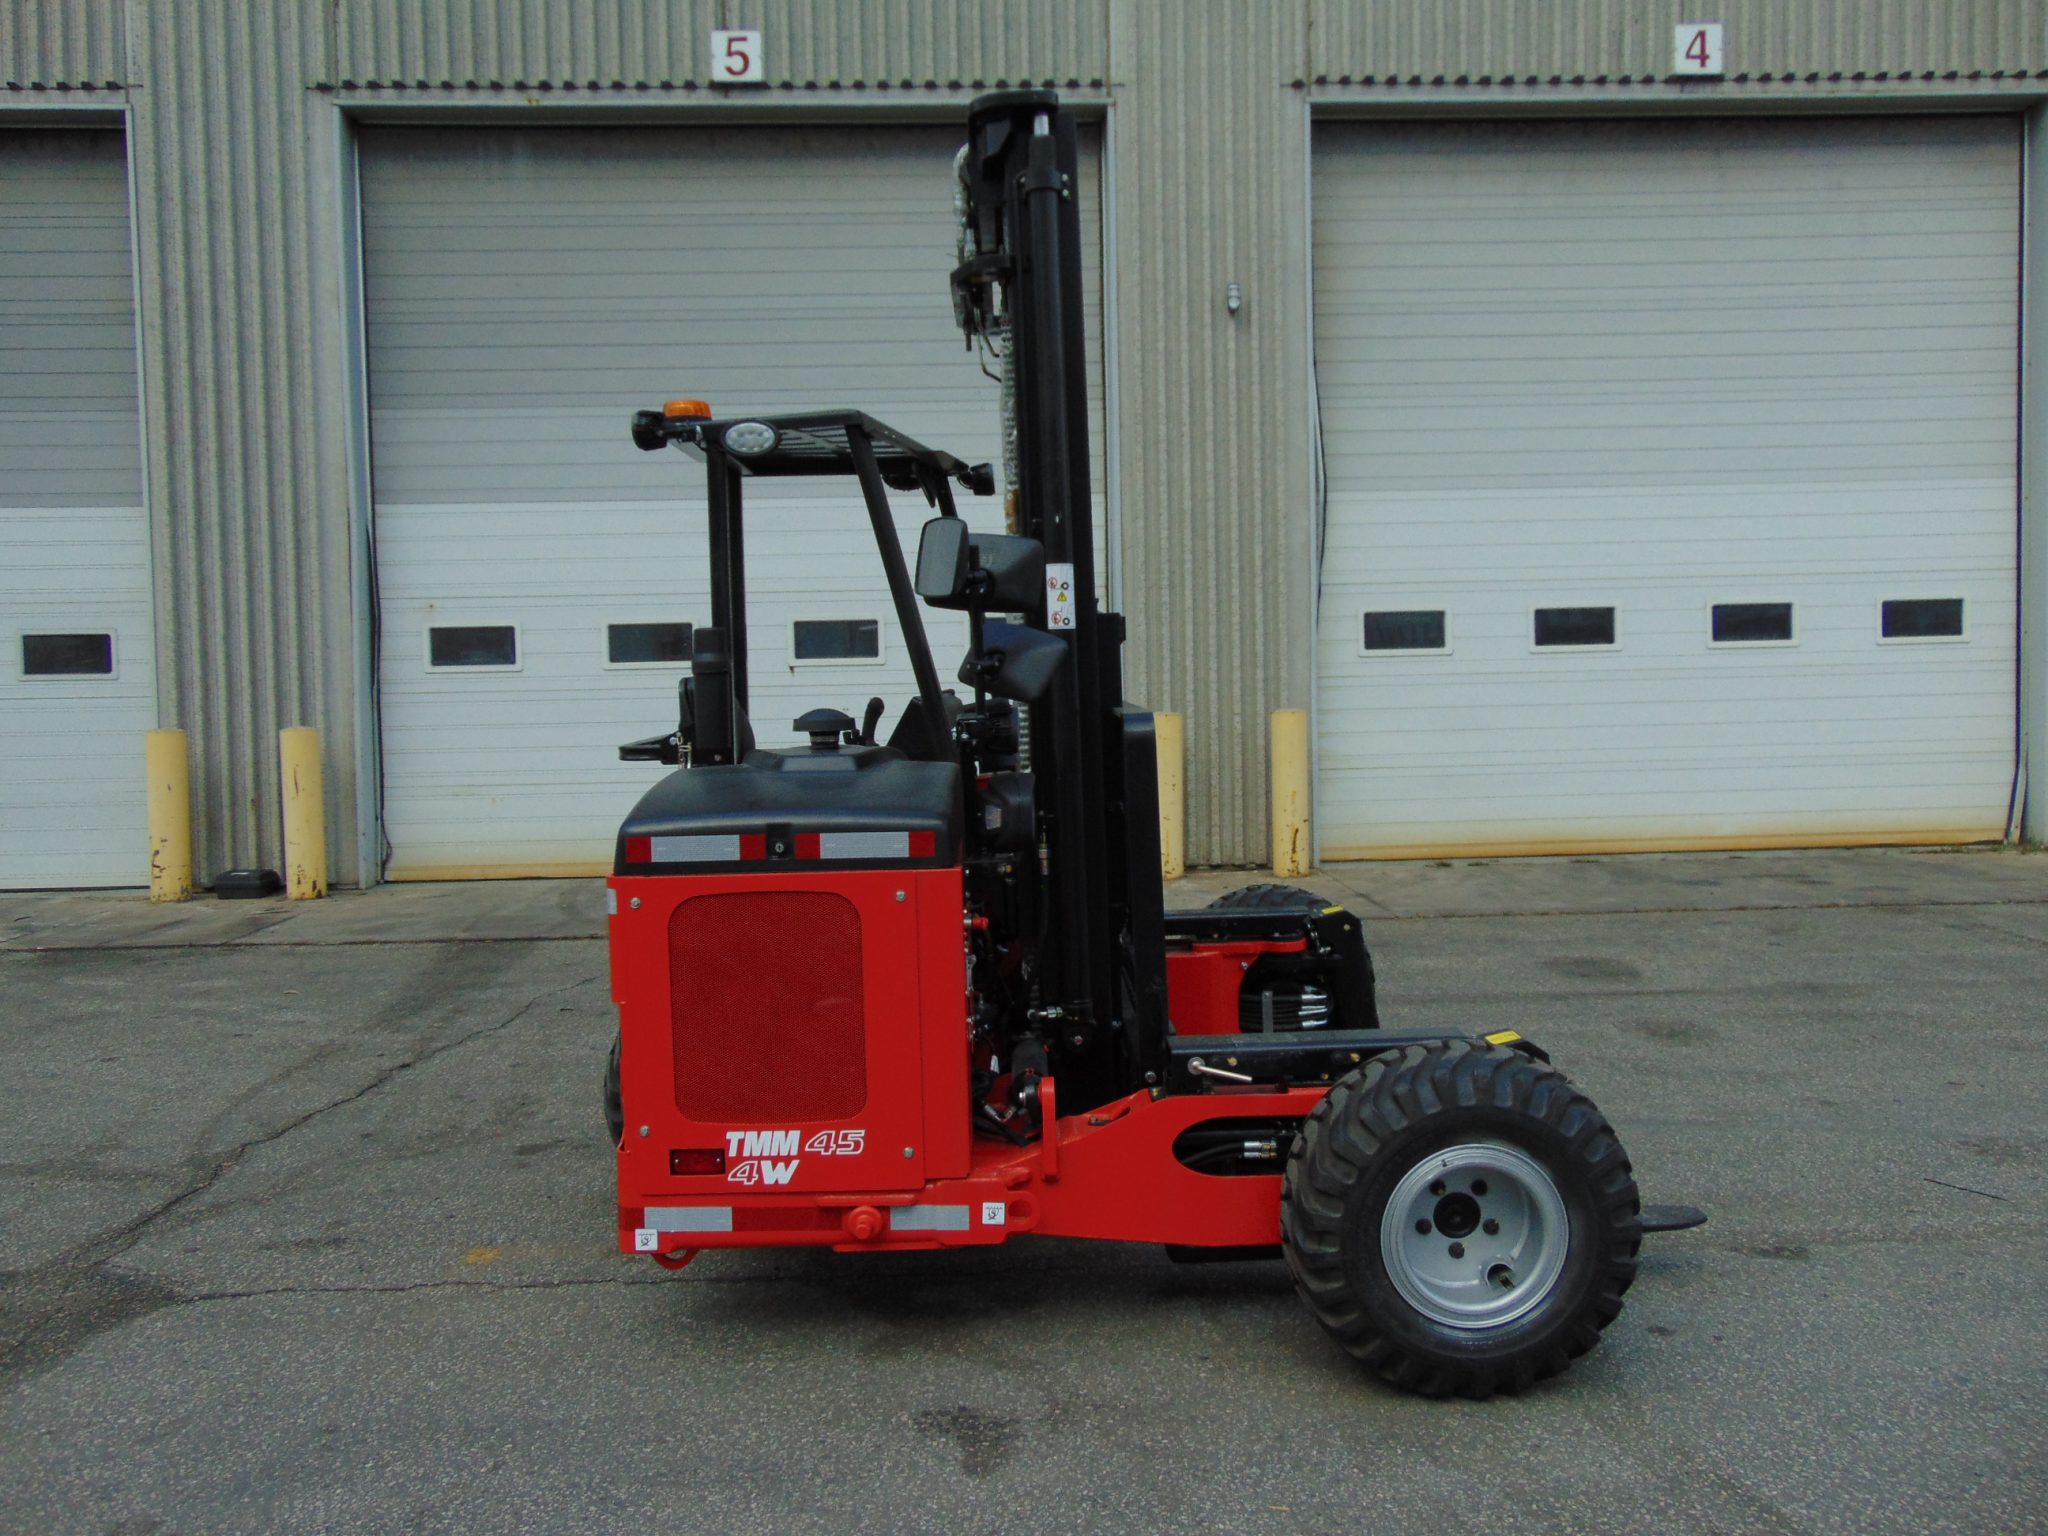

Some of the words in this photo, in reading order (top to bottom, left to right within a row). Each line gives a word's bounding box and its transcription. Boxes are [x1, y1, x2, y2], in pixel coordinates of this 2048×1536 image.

[725, 36, 750, 76] 5
[1685, 29, 1710, 68] 4
[726, 1130, 801, 1157] TMM
[804, 1129, 866, 1156] 45
[727, 1159, 800, 1186] 4W
